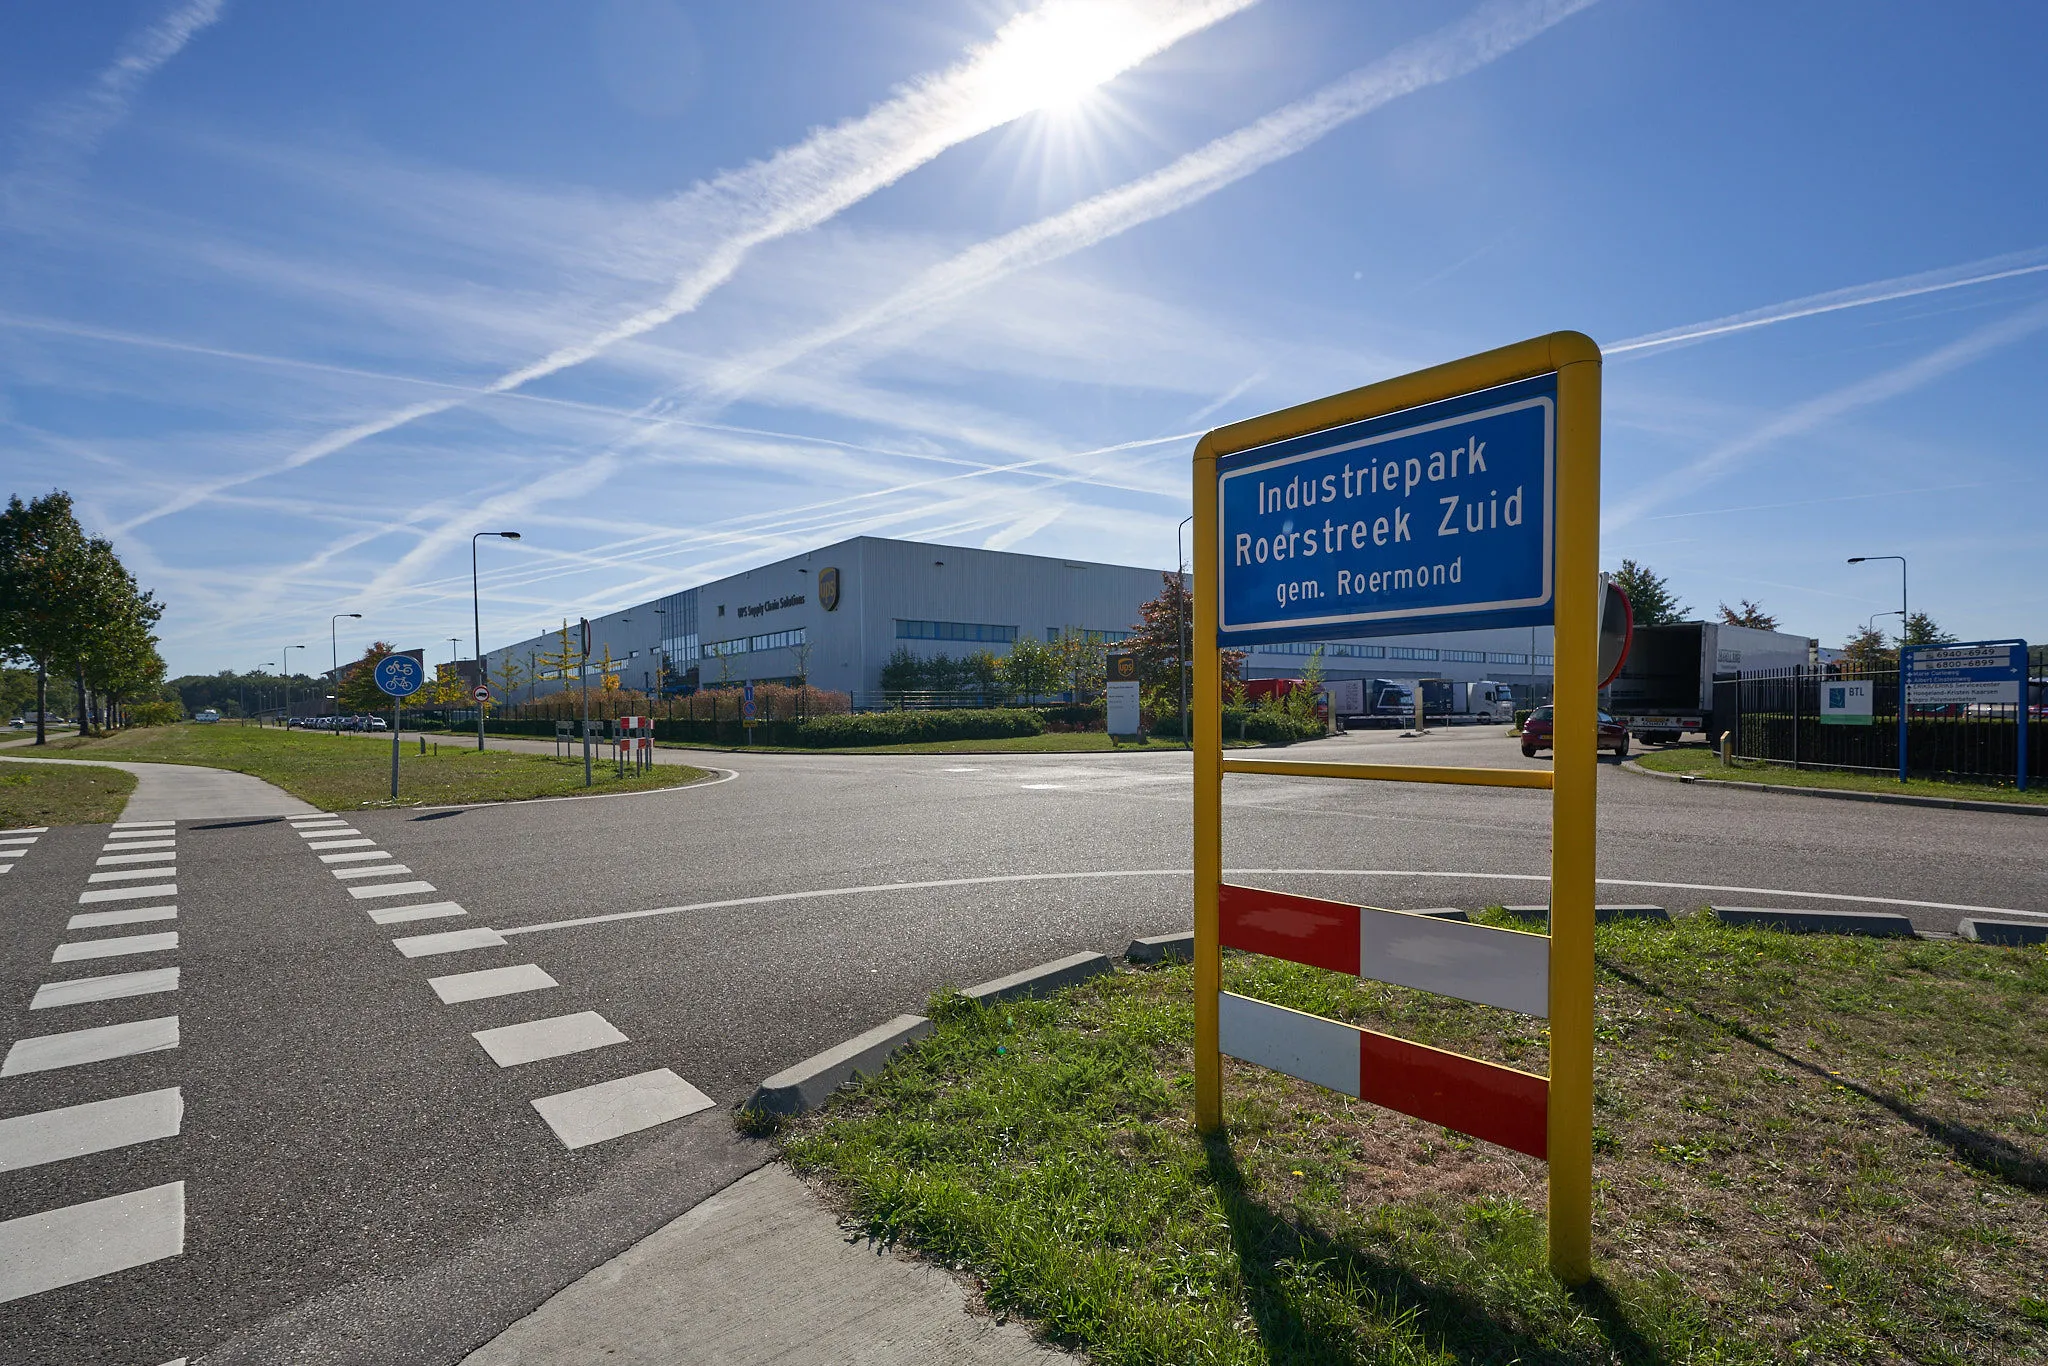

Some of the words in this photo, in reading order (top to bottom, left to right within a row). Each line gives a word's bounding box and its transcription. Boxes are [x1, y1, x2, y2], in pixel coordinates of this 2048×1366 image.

[1258, 434, 1488, 516] Industriepark
[1235, 505, 1412, 567] Roerstreek
[1437, 485, 1523, 538] Zuid
[820, 581, 835, 604] ups
[1276, 578, 1325, 609] gem.
[1337, 555, 1463, 597] Roermond
[738, 606, 748, 619] UPS
[748, 603, 764, 618] Supply
[764, 599, 780, 612] Chain
[780, 594, 805, 609] Solutions
[1848, 686, 1865, 697] BTL
